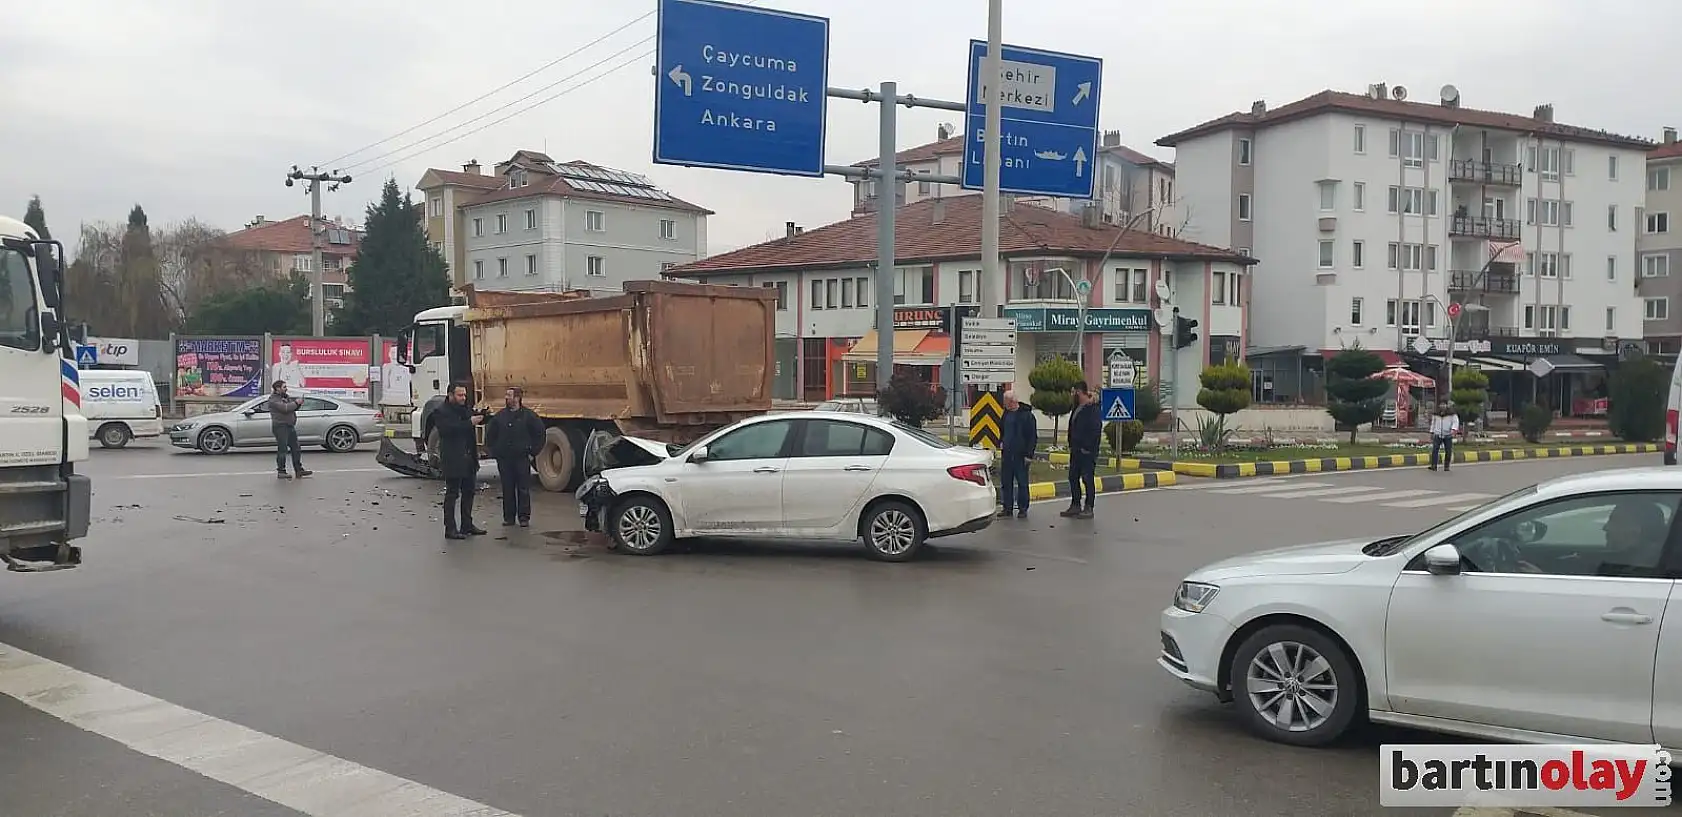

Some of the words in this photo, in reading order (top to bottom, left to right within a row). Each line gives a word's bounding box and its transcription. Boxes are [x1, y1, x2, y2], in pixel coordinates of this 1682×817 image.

[702, 44, 797, 72] Çaycuma
[1001, 66, 1040, 84] ehir
[701, 75, 809, 103] Zonguldak
[701, 108, 776, 132] Ankara
[976, 128, 1029, 148] Btın
[972, 150, 1031, 170] Lanı
[1051, 314, 1079, 328] Miray
[1084, 314, 1148, 328] Gayrimenkul
[296, 348, 338, 357] BURSLULUK
[1506, 342, 1537, 354] KUAFÖR
[1539, 343, 1560, 354] EMİN
[88, 384, 138, 398] selen
[10, 405, 51, 414] 2528
